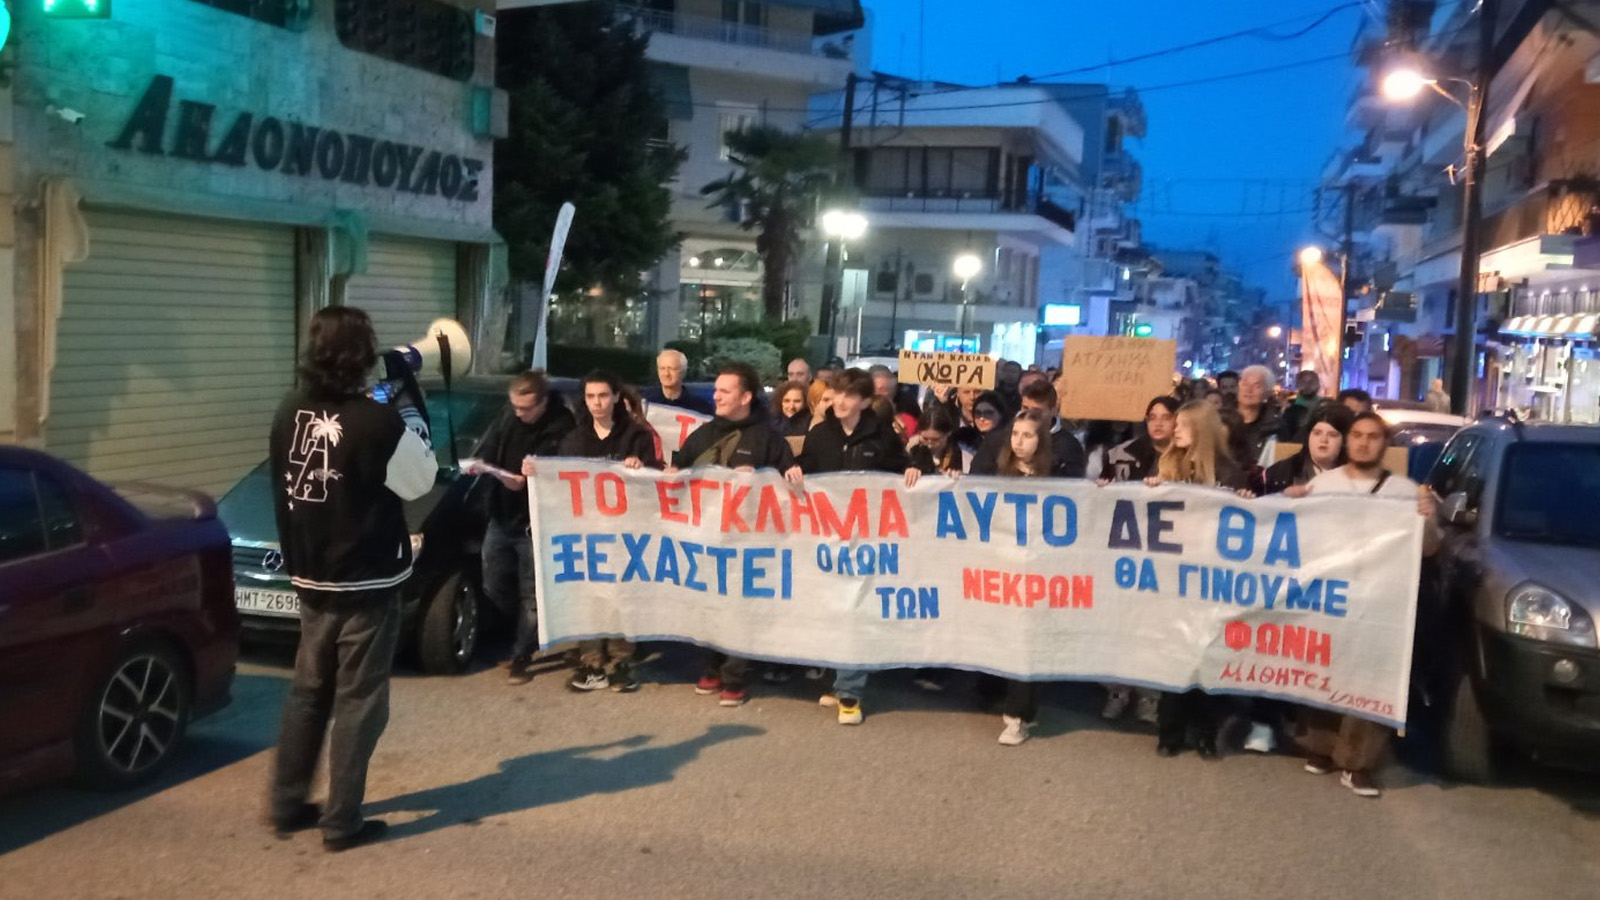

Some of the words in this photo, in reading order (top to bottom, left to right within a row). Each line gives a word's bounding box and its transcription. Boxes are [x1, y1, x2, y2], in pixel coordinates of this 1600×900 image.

[558, 471, 629, 518] ΤΟ
[656, 479, 910, 541] ΕΓΚΛΗΜΑ
[936, 491, 1078, 547] ΑΥΤΟ
[1107, 500, 1185, 554] ΔΕ
[1215, 506, 1301, 569] ΘΑ
[551, 534, 793, 600] ΞΕΧΑΣΤΕΙ
[817, 543, 899, 576] ΟΛΩΝ
[875, 587, 940, 620] ΤΩΝ
[962, 567, 1095, 610] ΝΕΚΡΩΝ
[1114, 557, 1159, 593] ΘΑ
[1178, 562, 1350, 618] ΓΙΝΟΥΜΕ
[1224, 620, 1333, 667] ΦΩΝΗ
